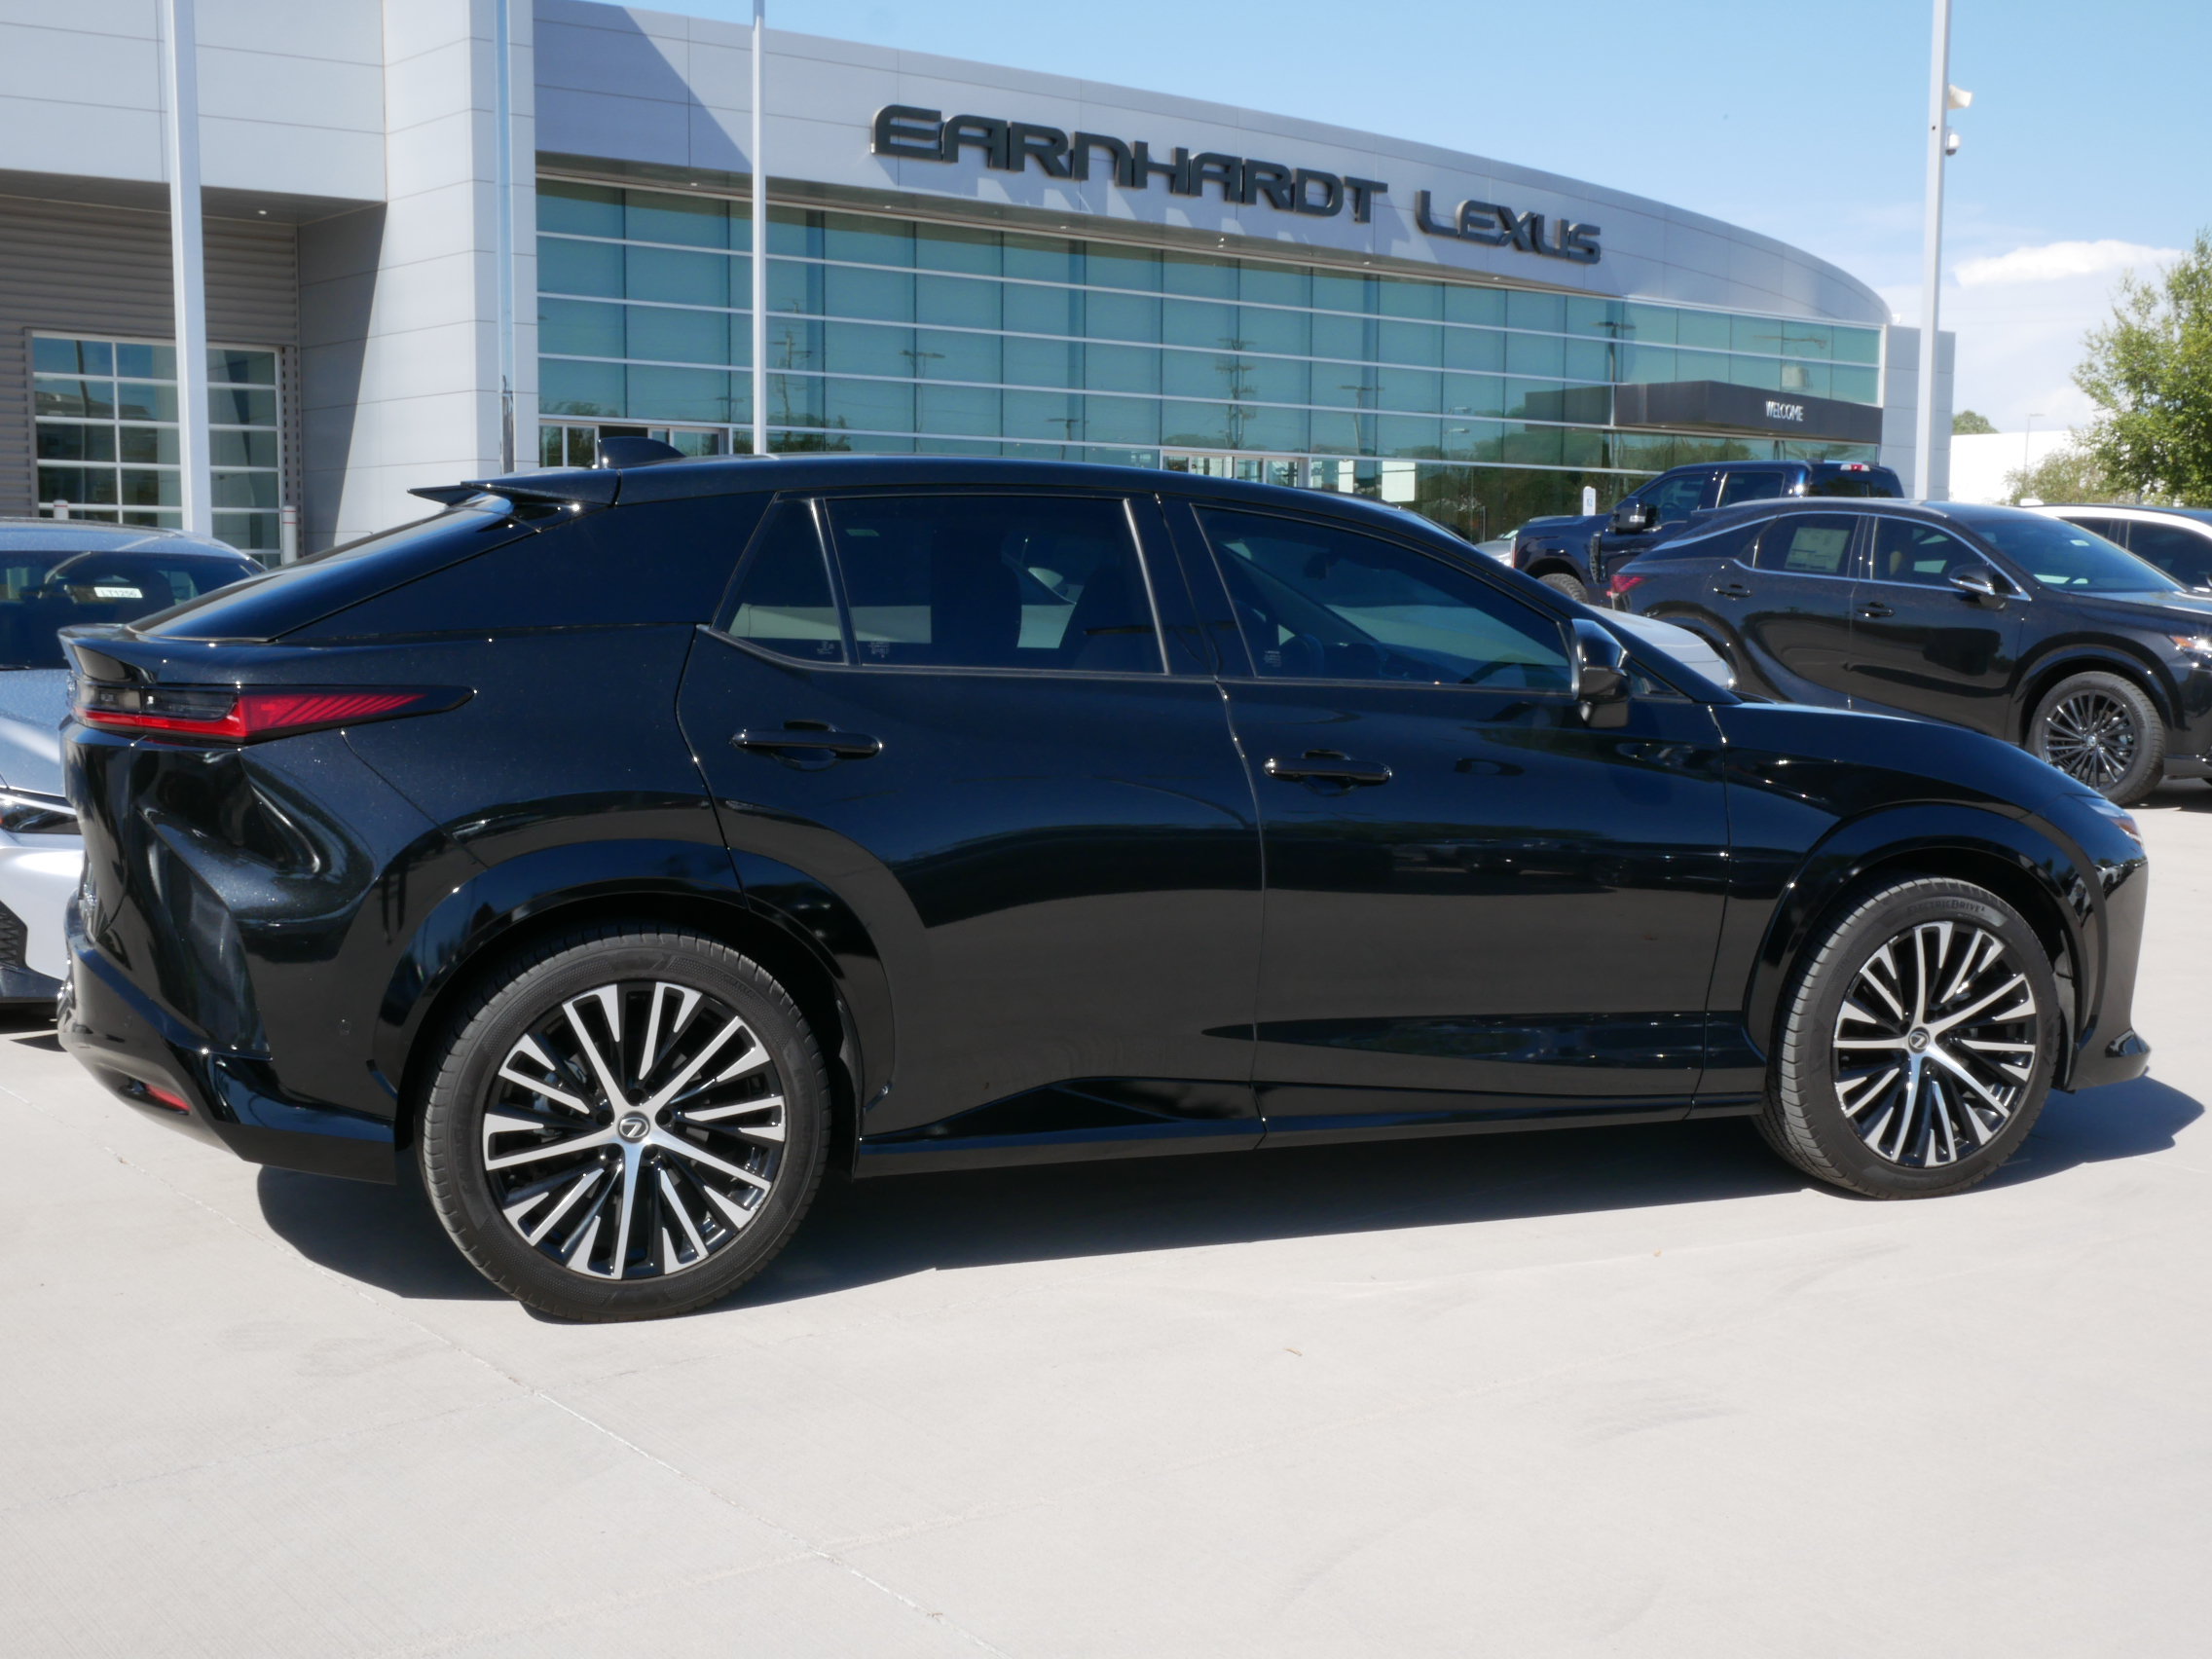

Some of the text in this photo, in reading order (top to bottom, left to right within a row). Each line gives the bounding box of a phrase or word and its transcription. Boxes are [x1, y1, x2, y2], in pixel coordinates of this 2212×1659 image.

[871, 104, 1602, 265] EARNHARDT LEXUS
[1765, 400, 1804, 422] WELCOME
